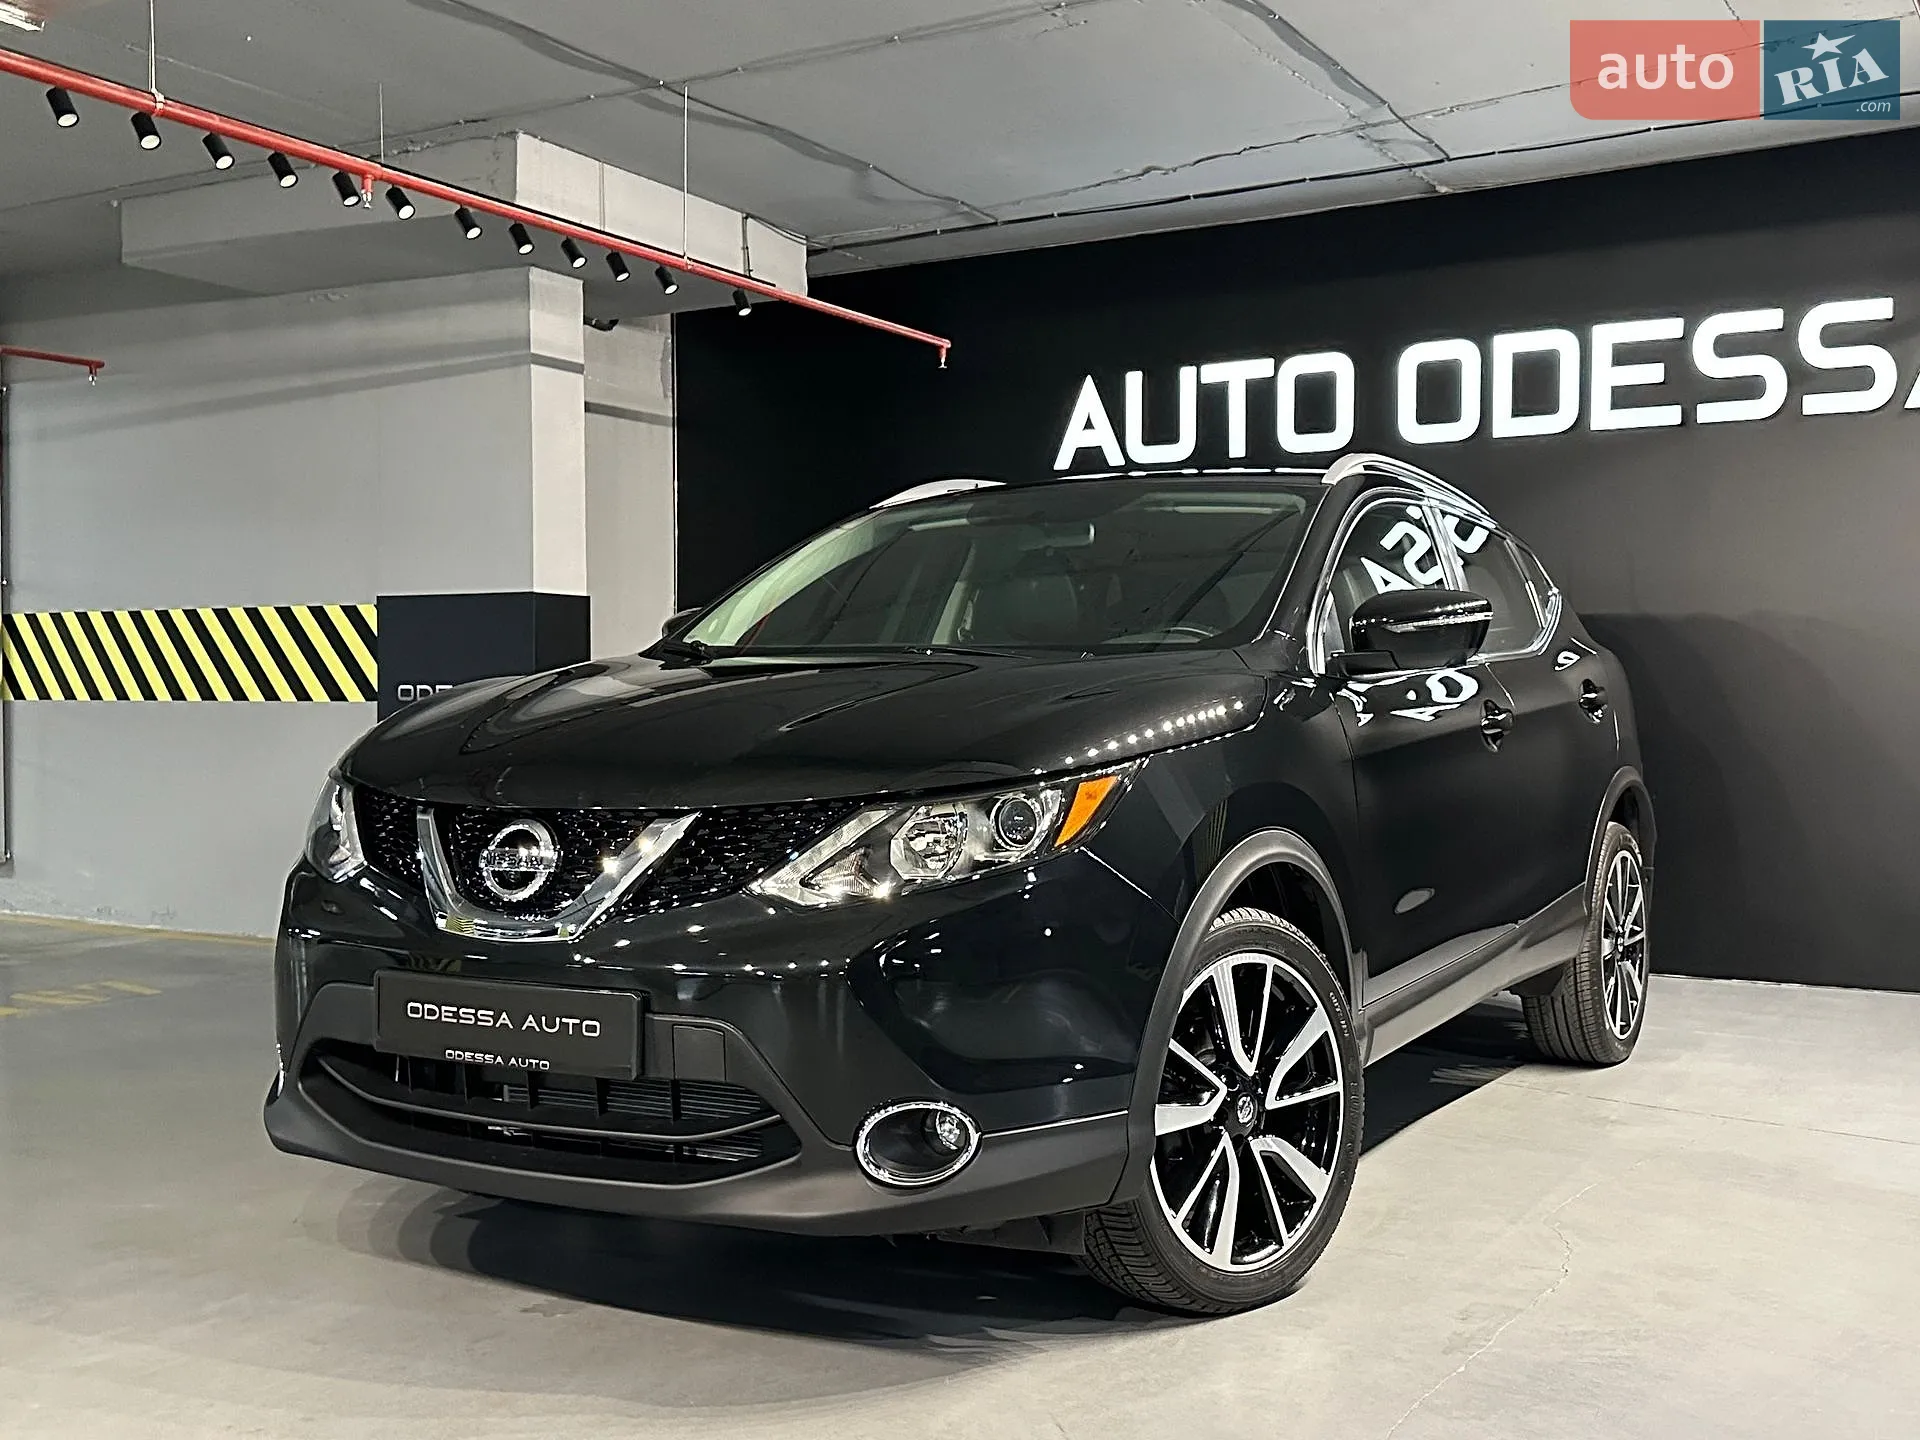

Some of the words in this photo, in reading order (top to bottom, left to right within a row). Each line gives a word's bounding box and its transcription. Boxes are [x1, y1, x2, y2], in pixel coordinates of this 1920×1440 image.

[1054, 352, 1355, 471] AUTO
[1397, 296, 1920, 446] ODESS
[407, 1001, 513, 1029] ODESSA
[522, 1014, 601, 1037] AUTO
[445, 1049, 505, 1065] ODESSA
[508, 1056, 550, 1071] AUTO
